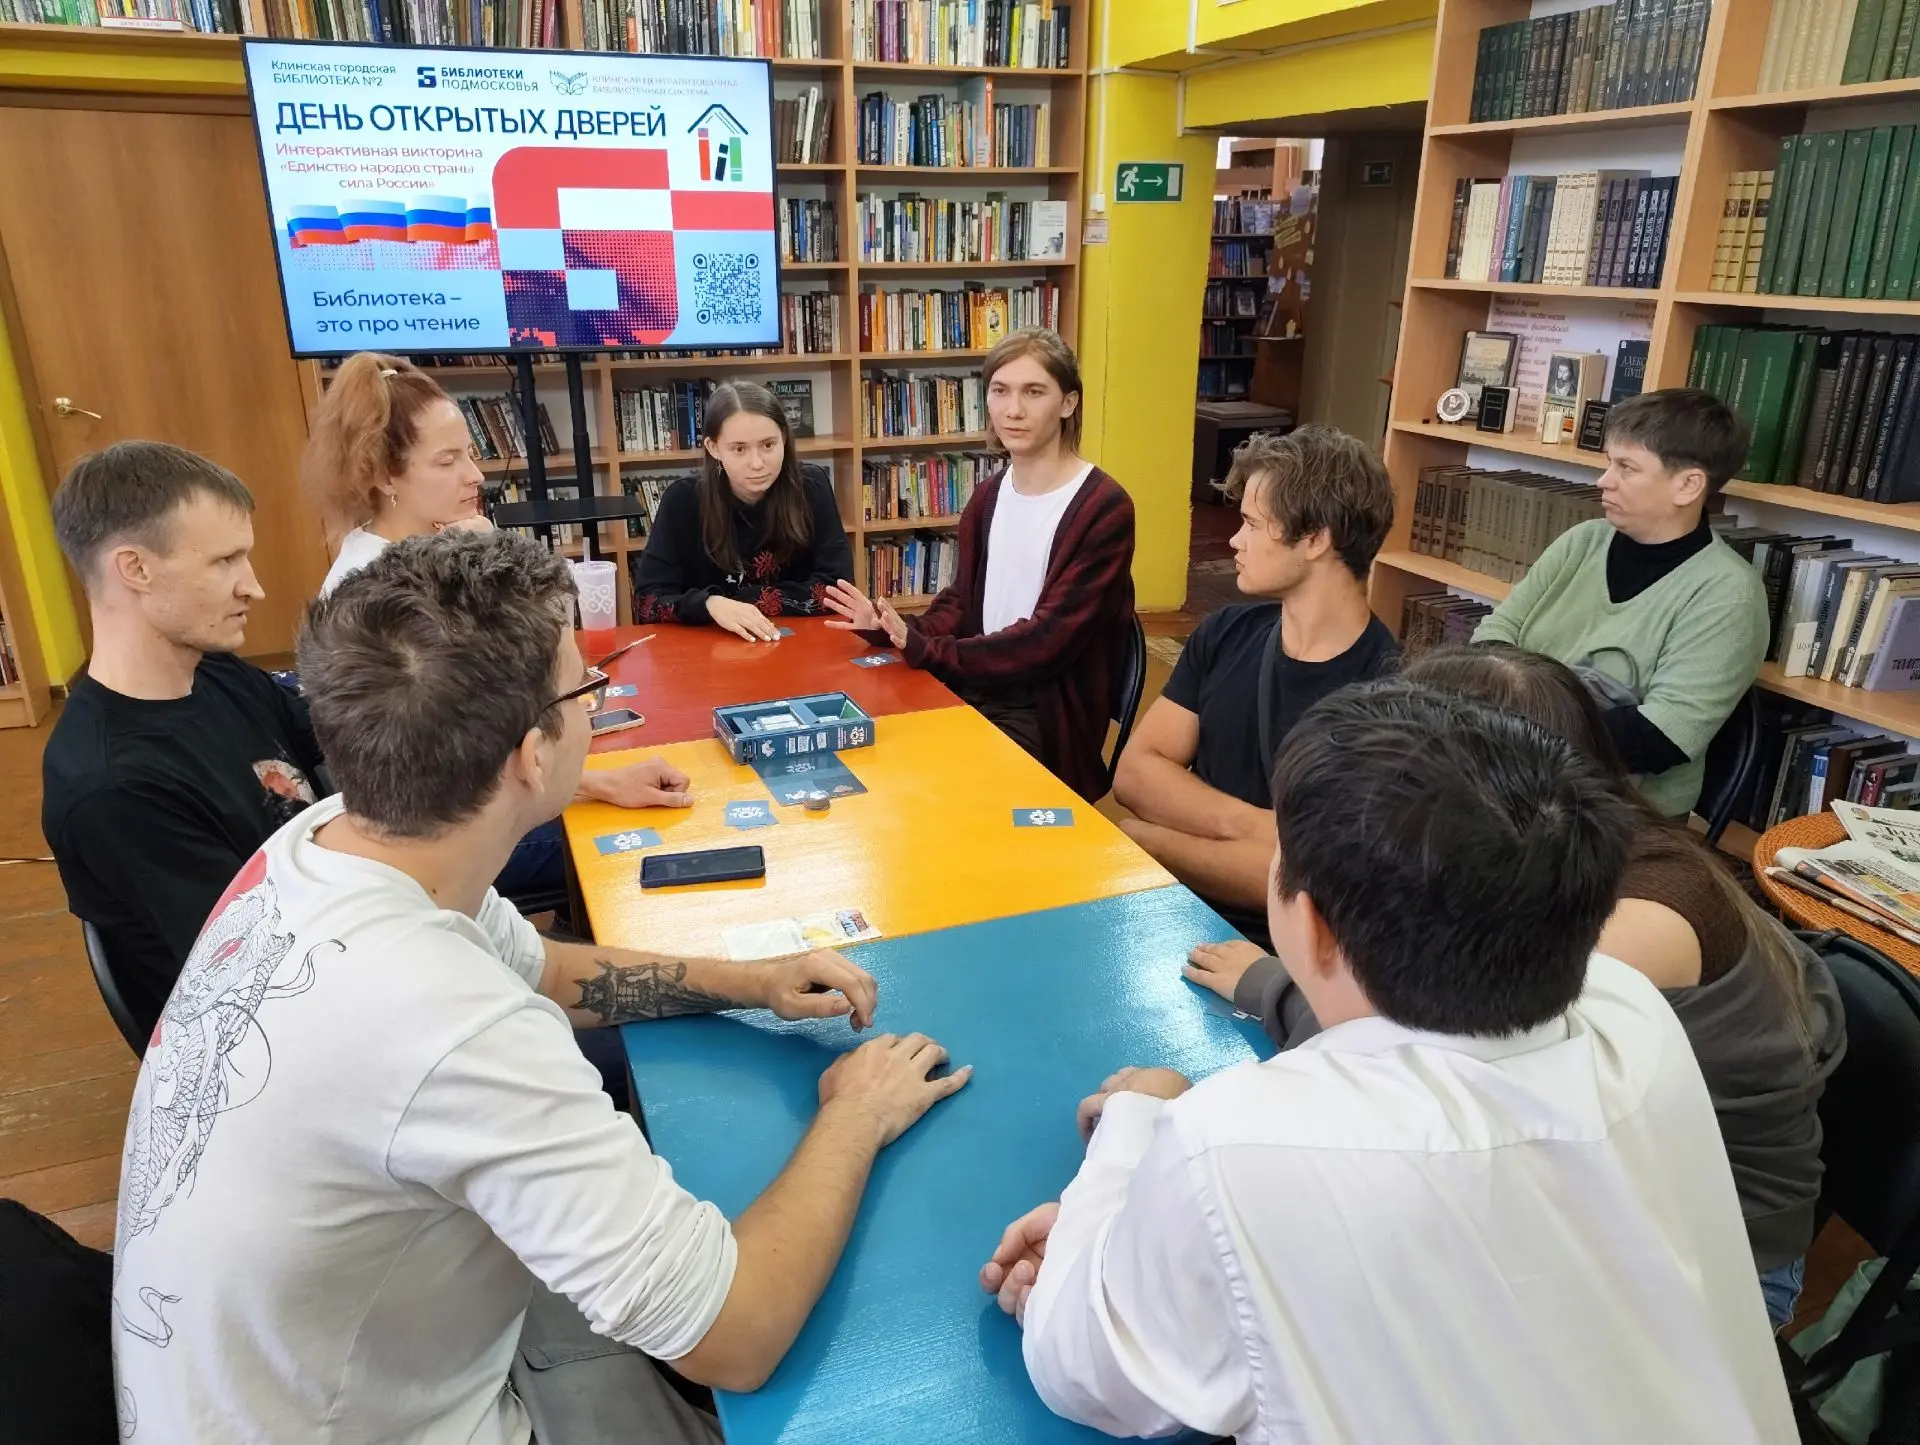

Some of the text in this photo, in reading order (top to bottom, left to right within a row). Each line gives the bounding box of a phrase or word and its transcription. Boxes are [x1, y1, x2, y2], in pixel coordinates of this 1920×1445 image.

[271, 60, 396, 74] Клинская городская
[441, 67, 524, 79] БИБЛИОТЕКИ
[273, 73, 383, 86] БИБЛИОТЕКА №2
[442, 80, 538, 91] ПОДМОСКОВЬЯ
[667, 88, 709, 96] СИСТЕМА
[275, 102, 667, 140] ДЕНЬ ОТКРЫТЫХ ДВЕРЕЙ
[275, 143, 483, 159] Интерактивная викторина
[280, 160, 475, 175] «Единство народов страны
[339, 178, 434, 188] сила России»
[312, 289, 446, 307] Библиотека
[316, 317, 480, 335] это про чтение
[1621, 355, 1648, 366] АЛЕКС
[1624, 366, 1645, 379] ПУШ
